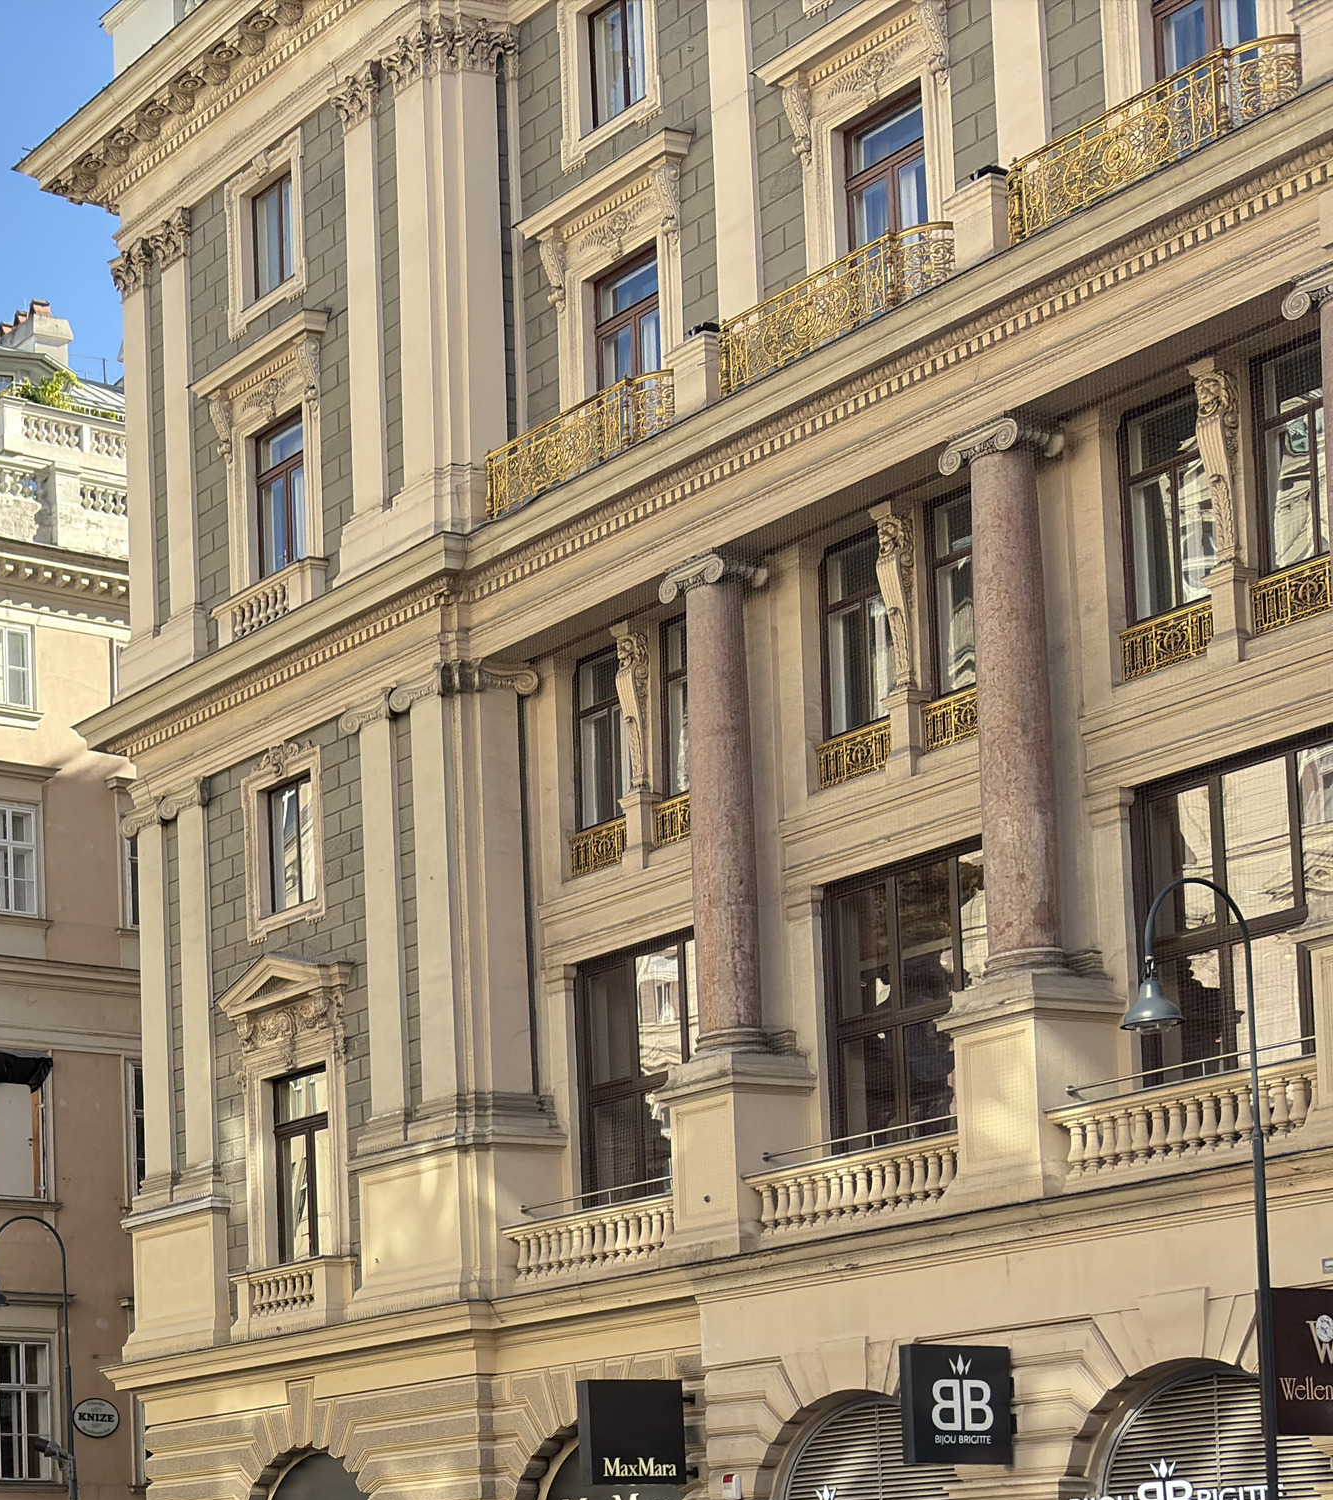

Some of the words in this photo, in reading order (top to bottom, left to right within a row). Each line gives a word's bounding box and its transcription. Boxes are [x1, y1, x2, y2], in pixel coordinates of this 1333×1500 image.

[78, 1412, 115, 1423] KNIZE
[934, 1434, 957, 1445] BIJOU
[958, 1434, 992, 1445] BRIGITTE
[603, 1457, 677, 1477] MaxMara
